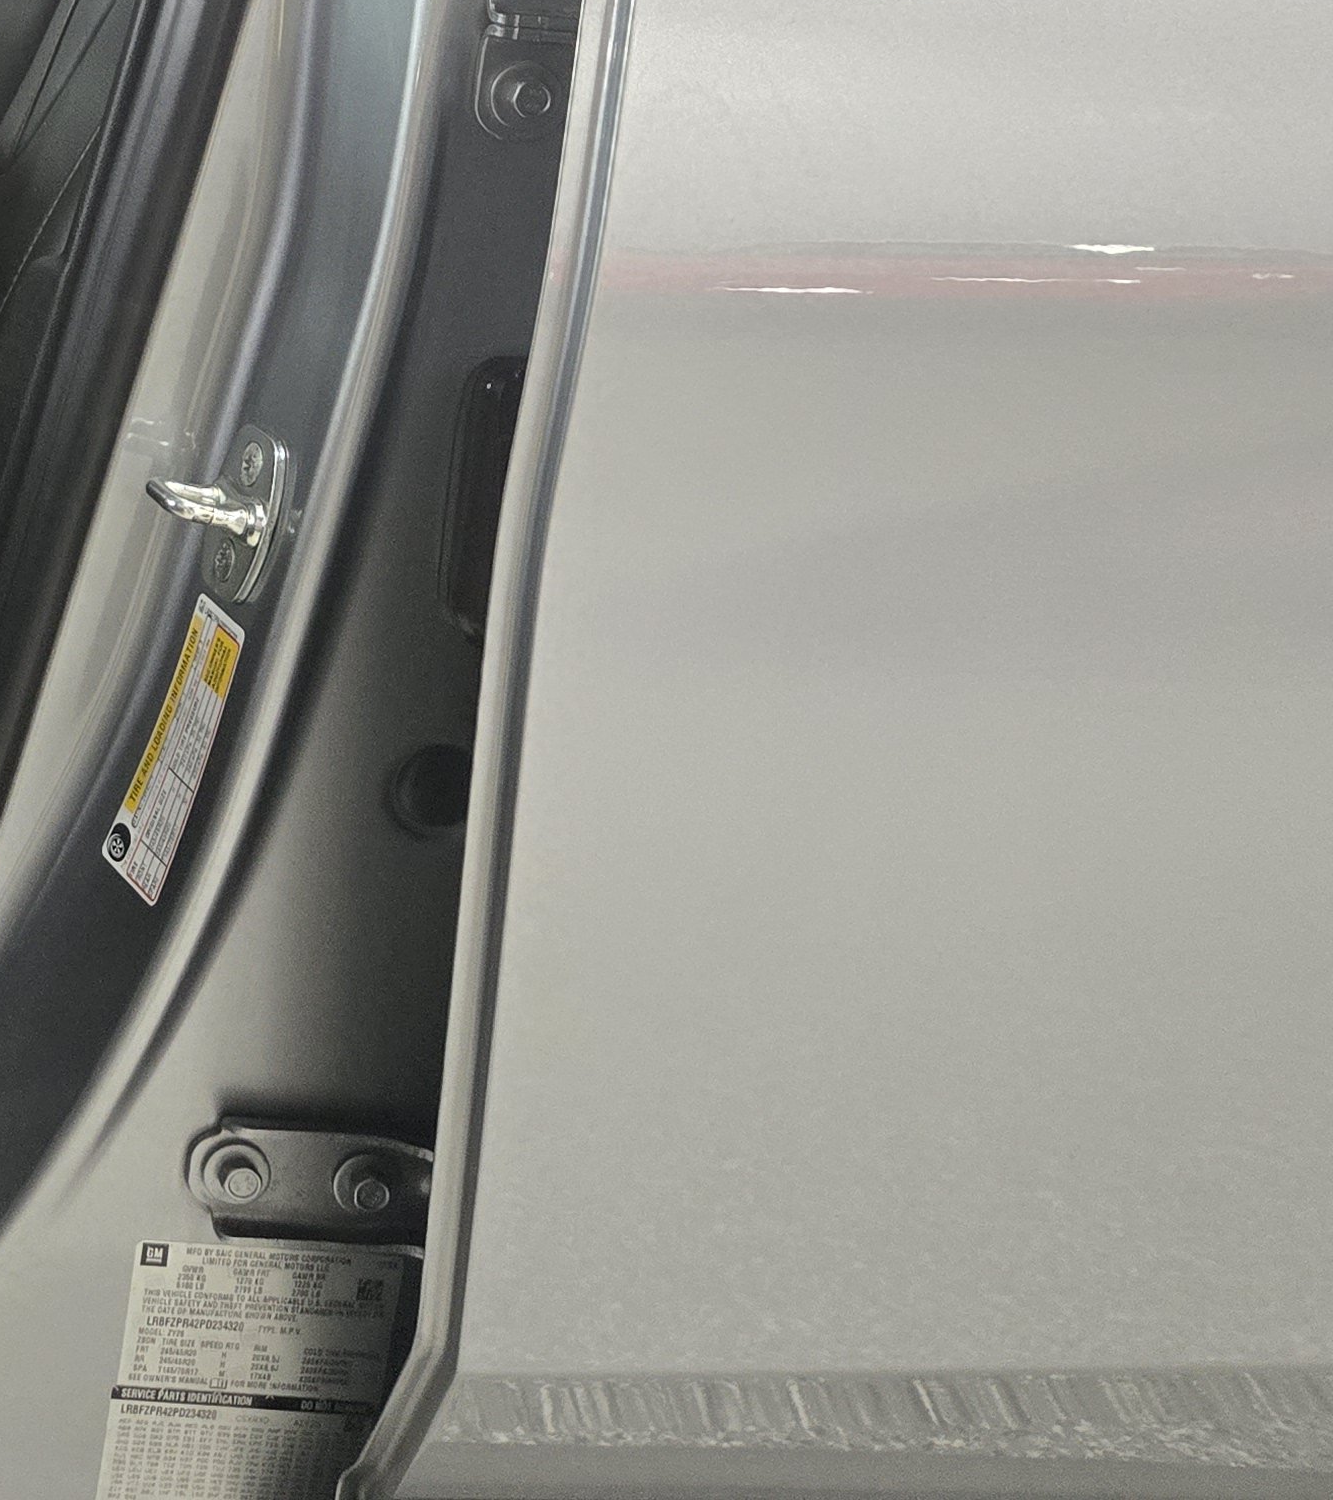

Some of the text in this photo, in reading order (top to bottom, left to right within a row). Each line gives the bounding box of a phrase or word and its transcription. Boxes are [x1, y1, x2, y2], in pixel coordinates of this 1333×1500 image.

[129, 777, 143, 802] TIRE
[139, 752, 154, 777] AND
[150, 703, 173, 751] LOADING
[169, 627, 198, 702] INFORMATION
[204, 1248, 214, 1256] BY
[234, 1250, 266, 1259] GENERAL
[269, 1252, 299, 1261] MOTORS
[202, 1257, 232, 1267] LIMITED
[233, 1258, 247, 1267] FOR
[249, 1260, 282, 1270] GENERAL
[284, 1262, 314, 1271] MOTORS
[144, 1288, 161, 1296] THIS
[162, 1289, 191, 1298] VEHICLE
[194, 1291, 234, 1301] CONFORMS
[236, 1294, 246, 1302] TO
[247, 1295, 260, 1303] ALL
[142, 1296, 173, 1306] VEHICLE
[174, 1298, 200, 1307] SAFETY
[203, 1300, 218, 1309] AND
[220, 1301, 242, 1310] THEFT
[244, 1303, 289, 1312] PREVENTION
[142, 1304, 156, 1313] THE
[157, 1305, 175, 1314] DATE
[177, 1307, 188, 1315] OF
[189, 1308, 242, 1319] MANUFACTURE
[200, 1340, 224, 1349] SPEED
[128, 1373, 141, 1381] SEE
[143, 1374, 177, 1383] OWNER'S
[178, 1376, 209, 1385] MANUAL
[247, 1381, 267, 1389] MORE
[121, 1388, 157, 1400] SERVICE
[157, 1388, 186, 1402] PARTS
[187, 1391, 253, 1406] IDENTIFICATION
